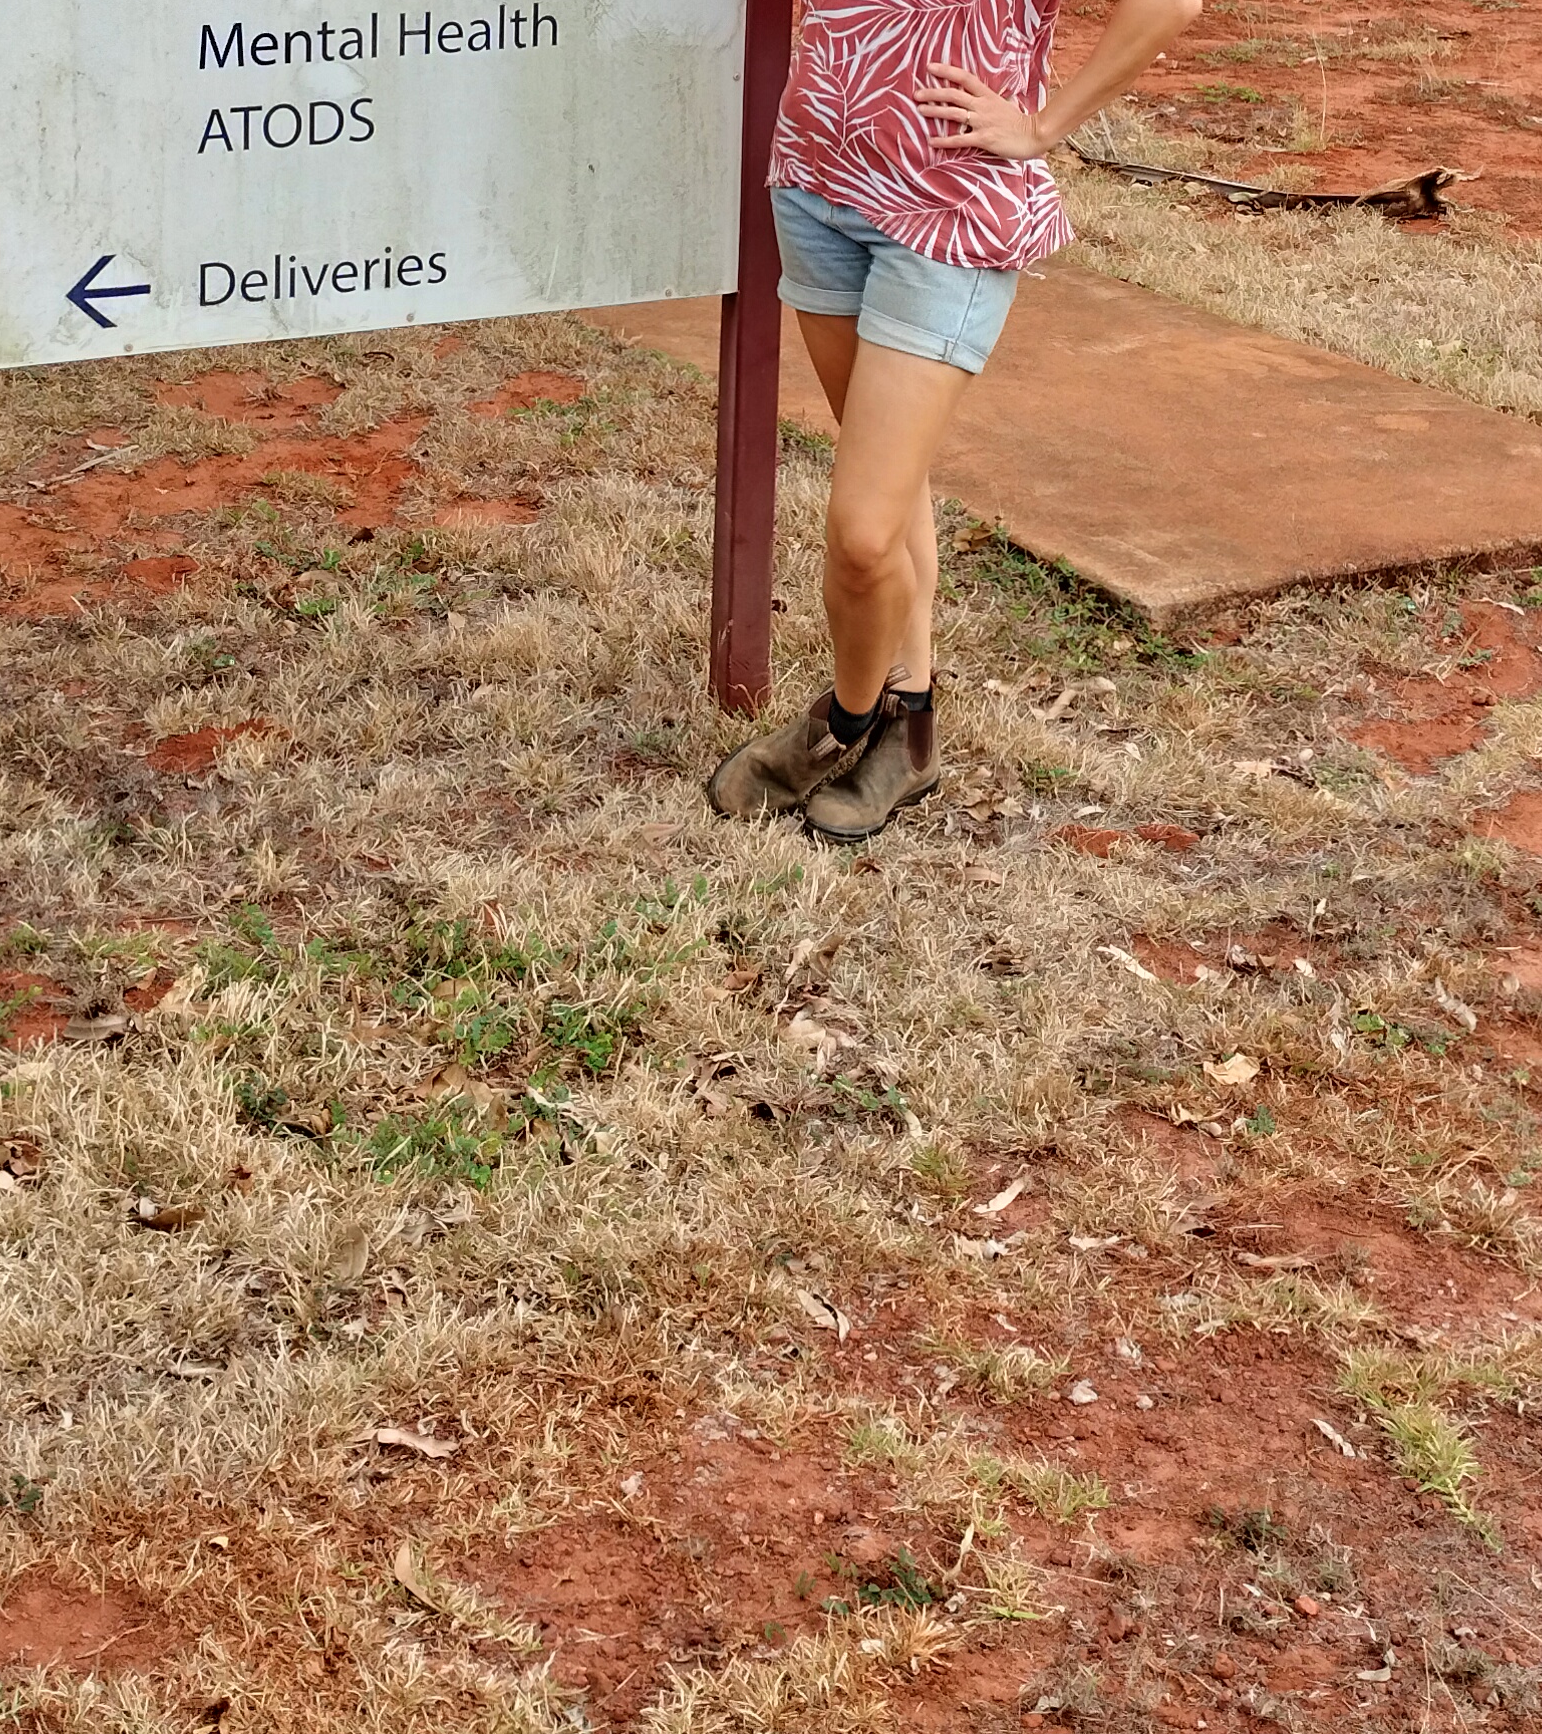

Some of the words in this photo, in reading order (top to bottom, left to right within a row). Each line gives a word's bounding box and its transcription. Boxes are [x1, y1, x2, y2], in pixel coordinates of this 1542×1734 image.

[200, 13, 377, 69] Mental
[400, 3, 557, 56] Health
[198, 98, 374, 153] ATODS
[200, 247, 446, 306] Deliveries
